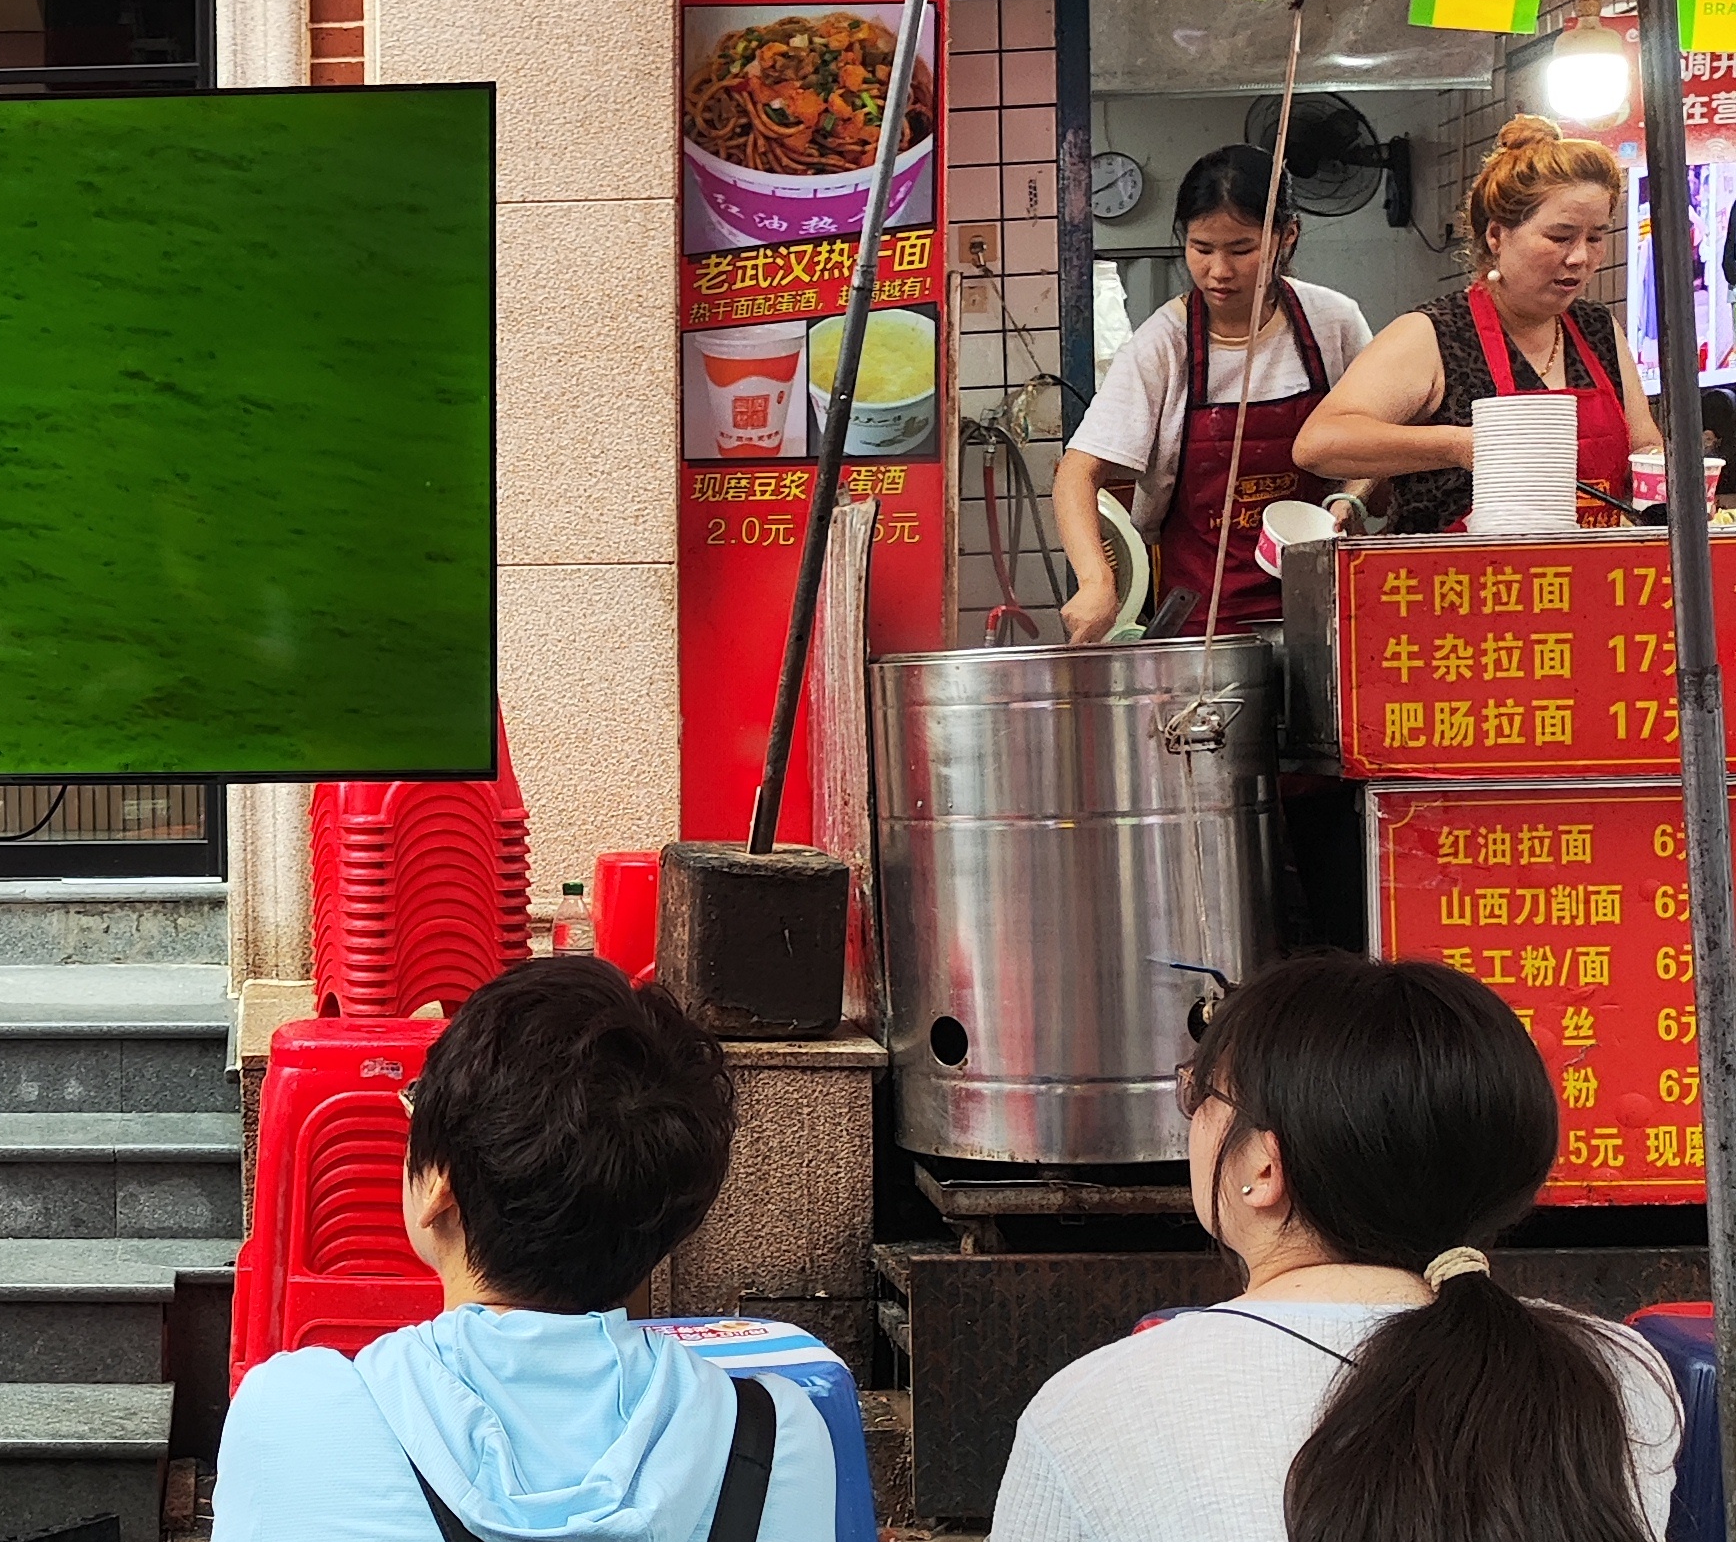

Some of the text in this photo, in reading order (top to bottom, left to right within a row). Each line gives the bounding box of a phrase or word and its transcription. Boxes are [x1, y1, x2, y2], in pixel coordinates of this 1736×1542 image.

[1703, 2, 1736, 15] BRA
[1680, 52, 1736, 82] 调开
[1682, 90, 1736, 126] 在营
[691, 469, 810, 502] 现磨豆浆
[706, 514, 796, 546] 2.0元
[1380, 564, 1574, 617] 牛肉拉面
[1381, 631, 1575, 683] 牛杂拉面
[1383, 697, 1576, 748] 肥肠拉面
[1437, 822, 1687, 865] 红油拉面 6
[1440, 884, 1623, 926] 山西刀削面
[1558, 1127, 1625, 1168] .5元
